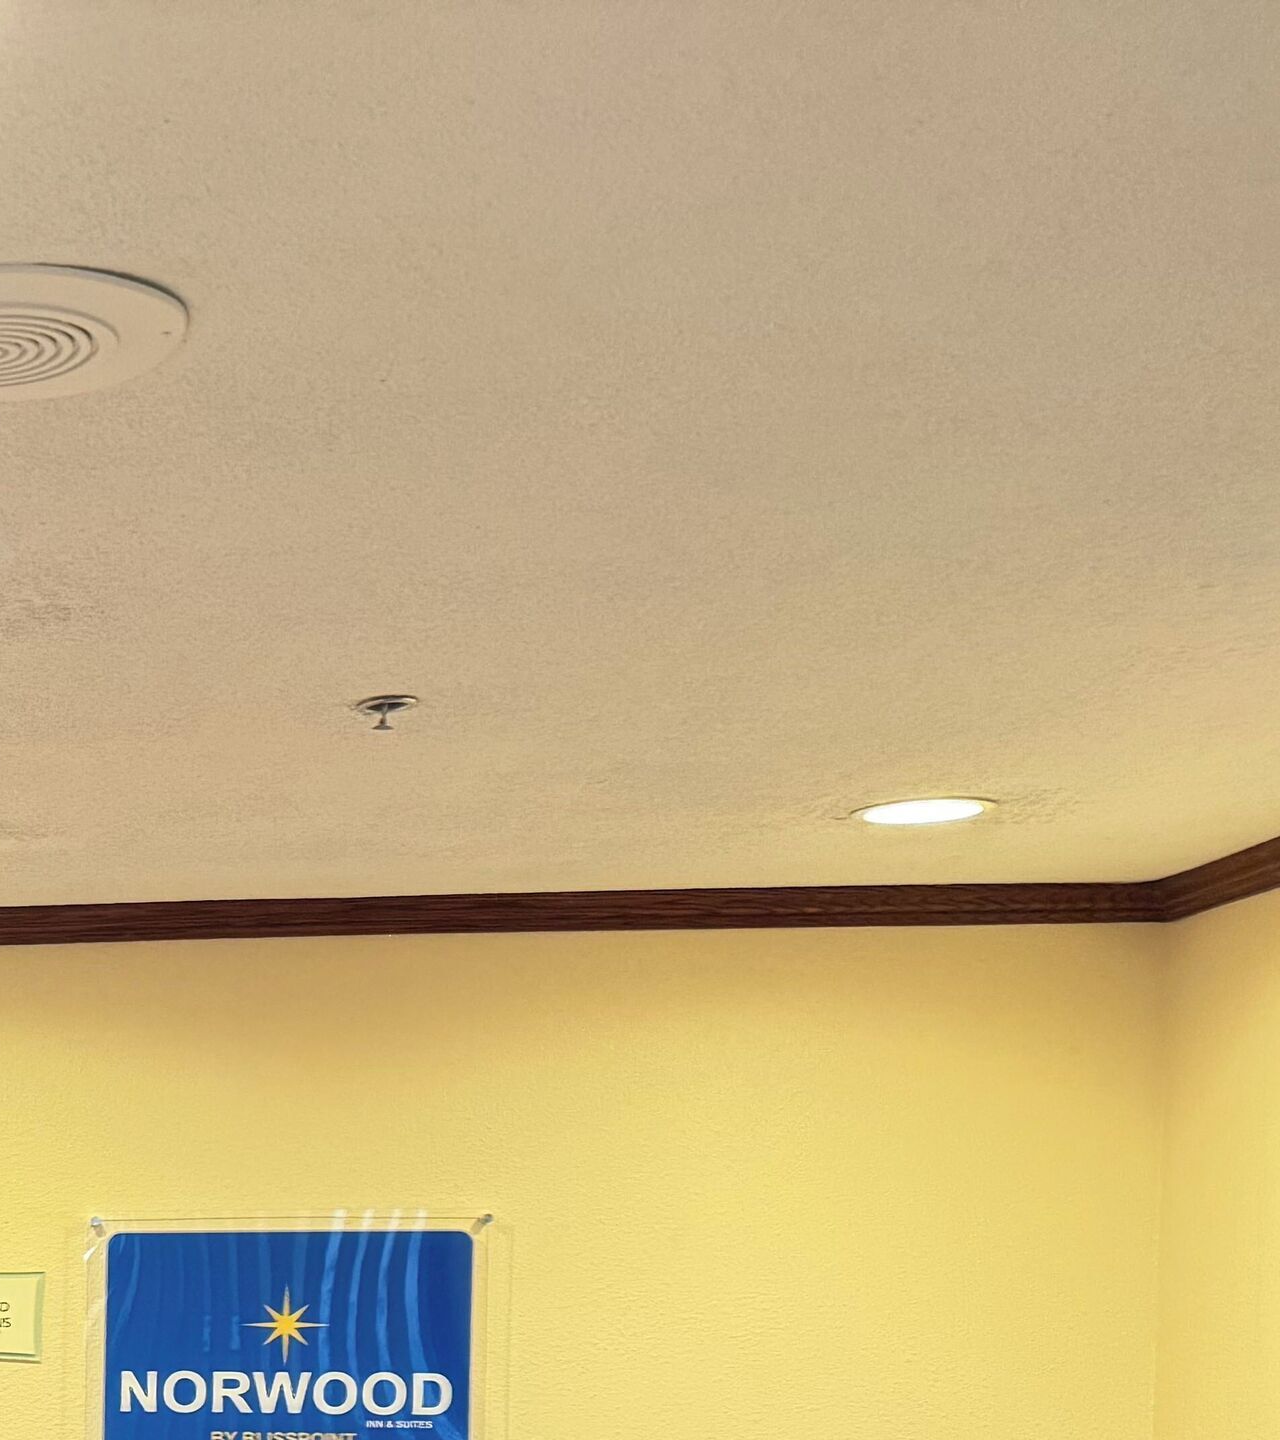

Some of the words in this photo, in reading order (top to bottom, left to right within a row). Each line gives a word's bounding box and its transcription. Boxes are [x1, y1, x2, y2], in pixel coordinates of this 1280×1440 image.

[119, 1370, 453, 1416] NORWOOD
[365, 1420, 383, 1428] INN
[395, 1421, 433, 1429] SUITES
